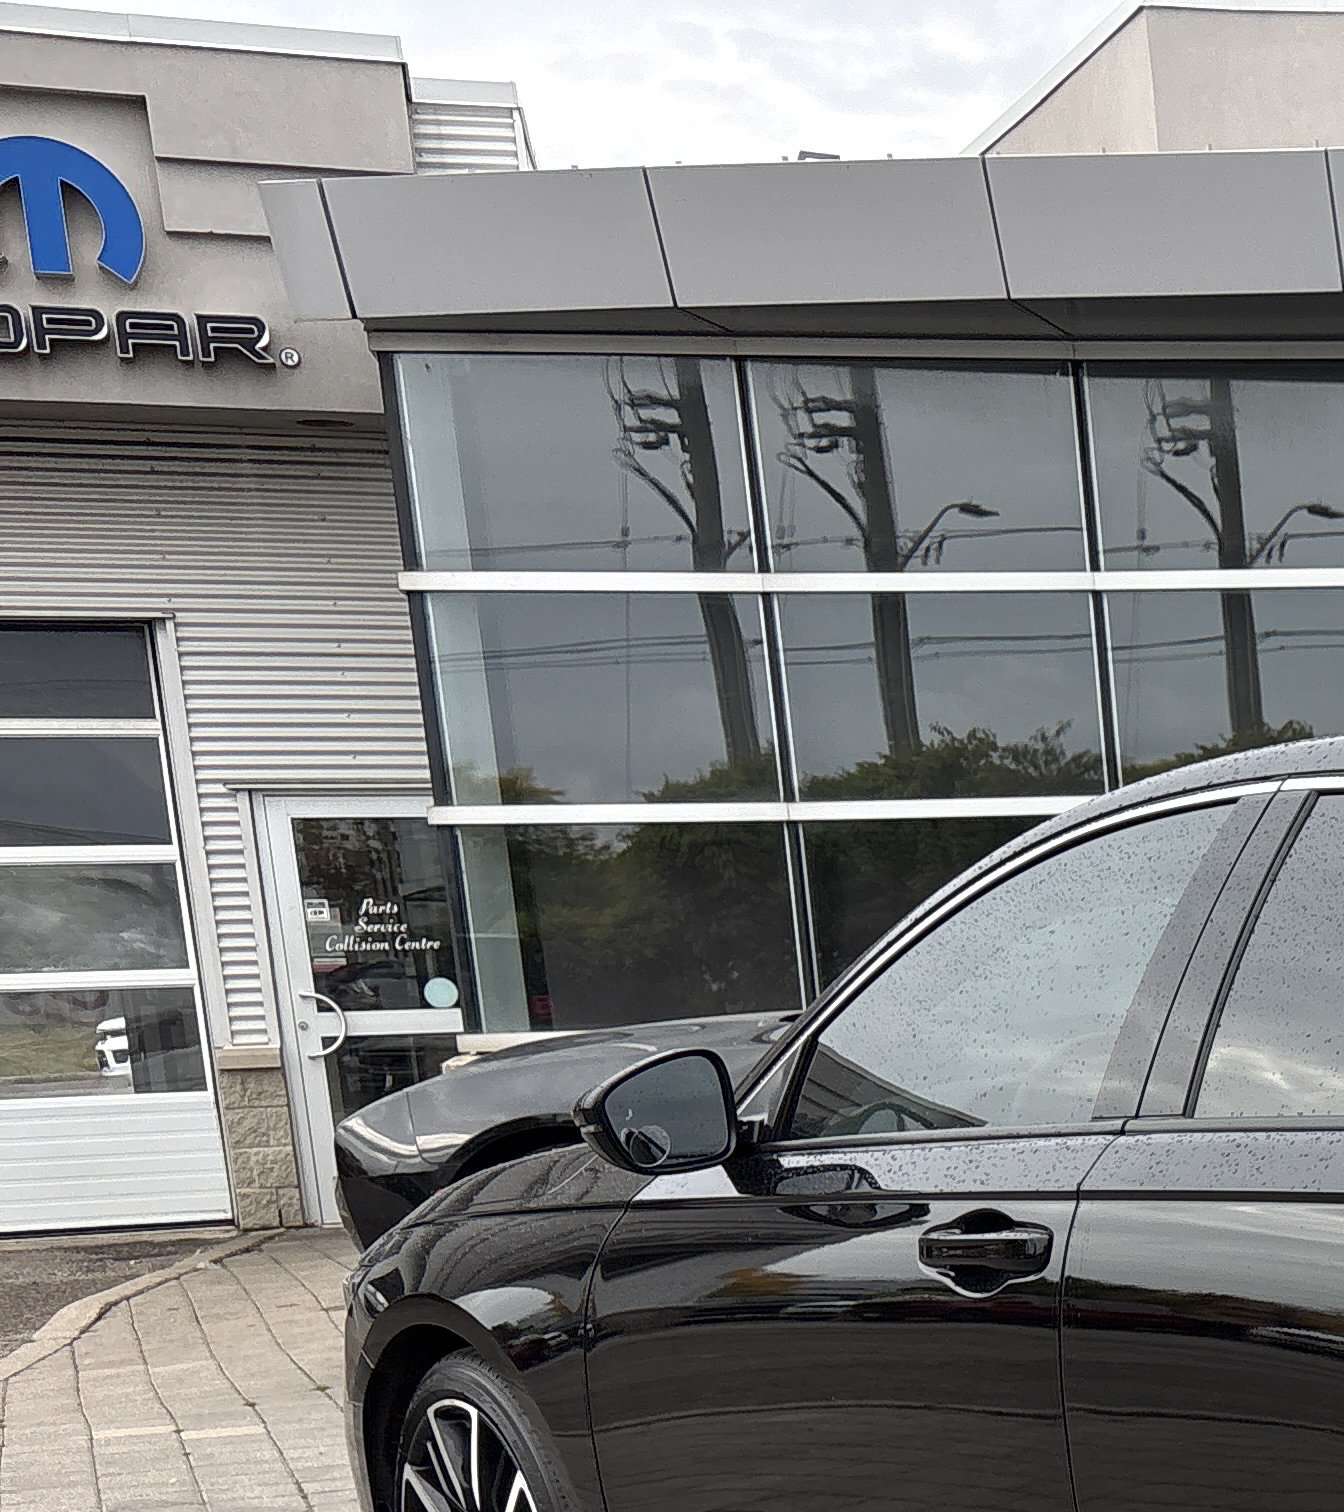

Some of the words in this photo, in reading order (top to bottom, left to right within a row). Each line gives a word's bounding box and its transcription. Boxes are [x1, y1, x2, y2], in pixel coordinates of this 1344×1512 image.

[359, 897, 399, 916] Parts
[354, 916, 408, 933] Service
[325, 935, 390, 952] Collision
[395, 934, 441, 950] Centre
